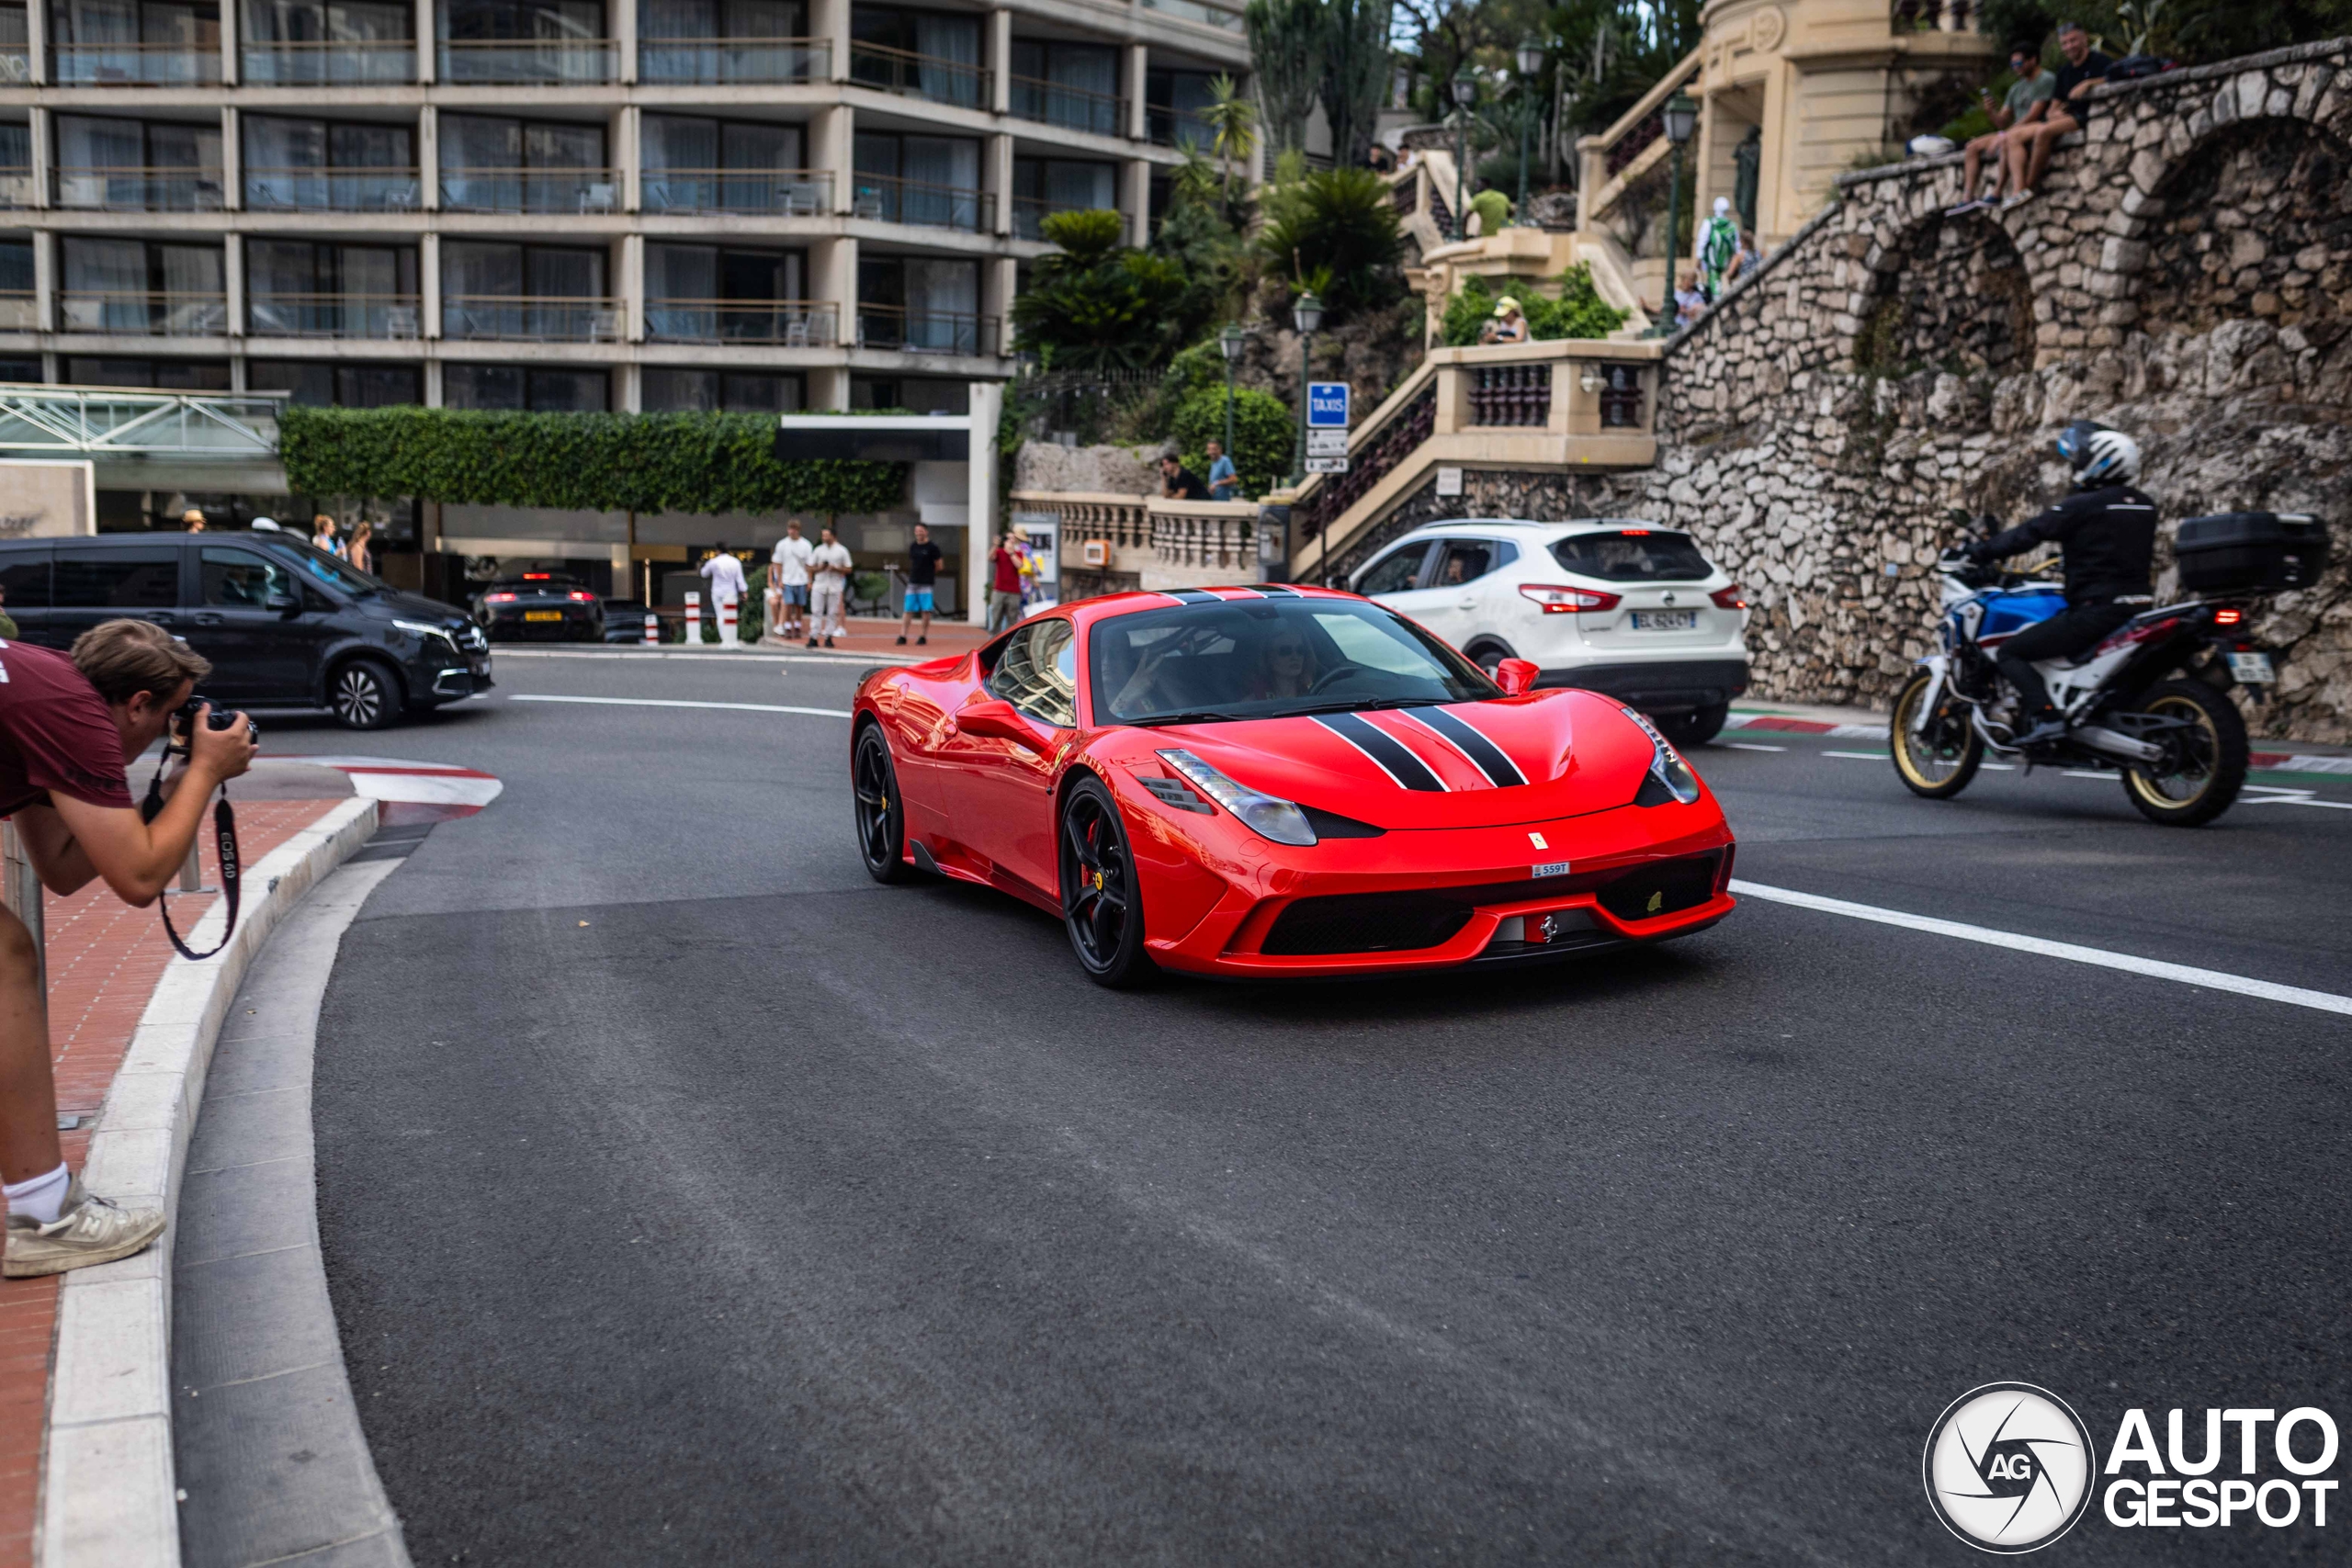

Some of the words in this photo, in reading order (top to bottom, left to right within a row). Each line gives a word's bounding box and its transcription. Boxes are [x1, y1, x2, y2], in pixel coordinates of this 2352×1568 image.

[1312, 398, 1344, 412] TAXIS
[220, 832, 234, 861] EOS
[223, 863, 236, 879] 6D
[1543, 863, 1567, 874] 559T
